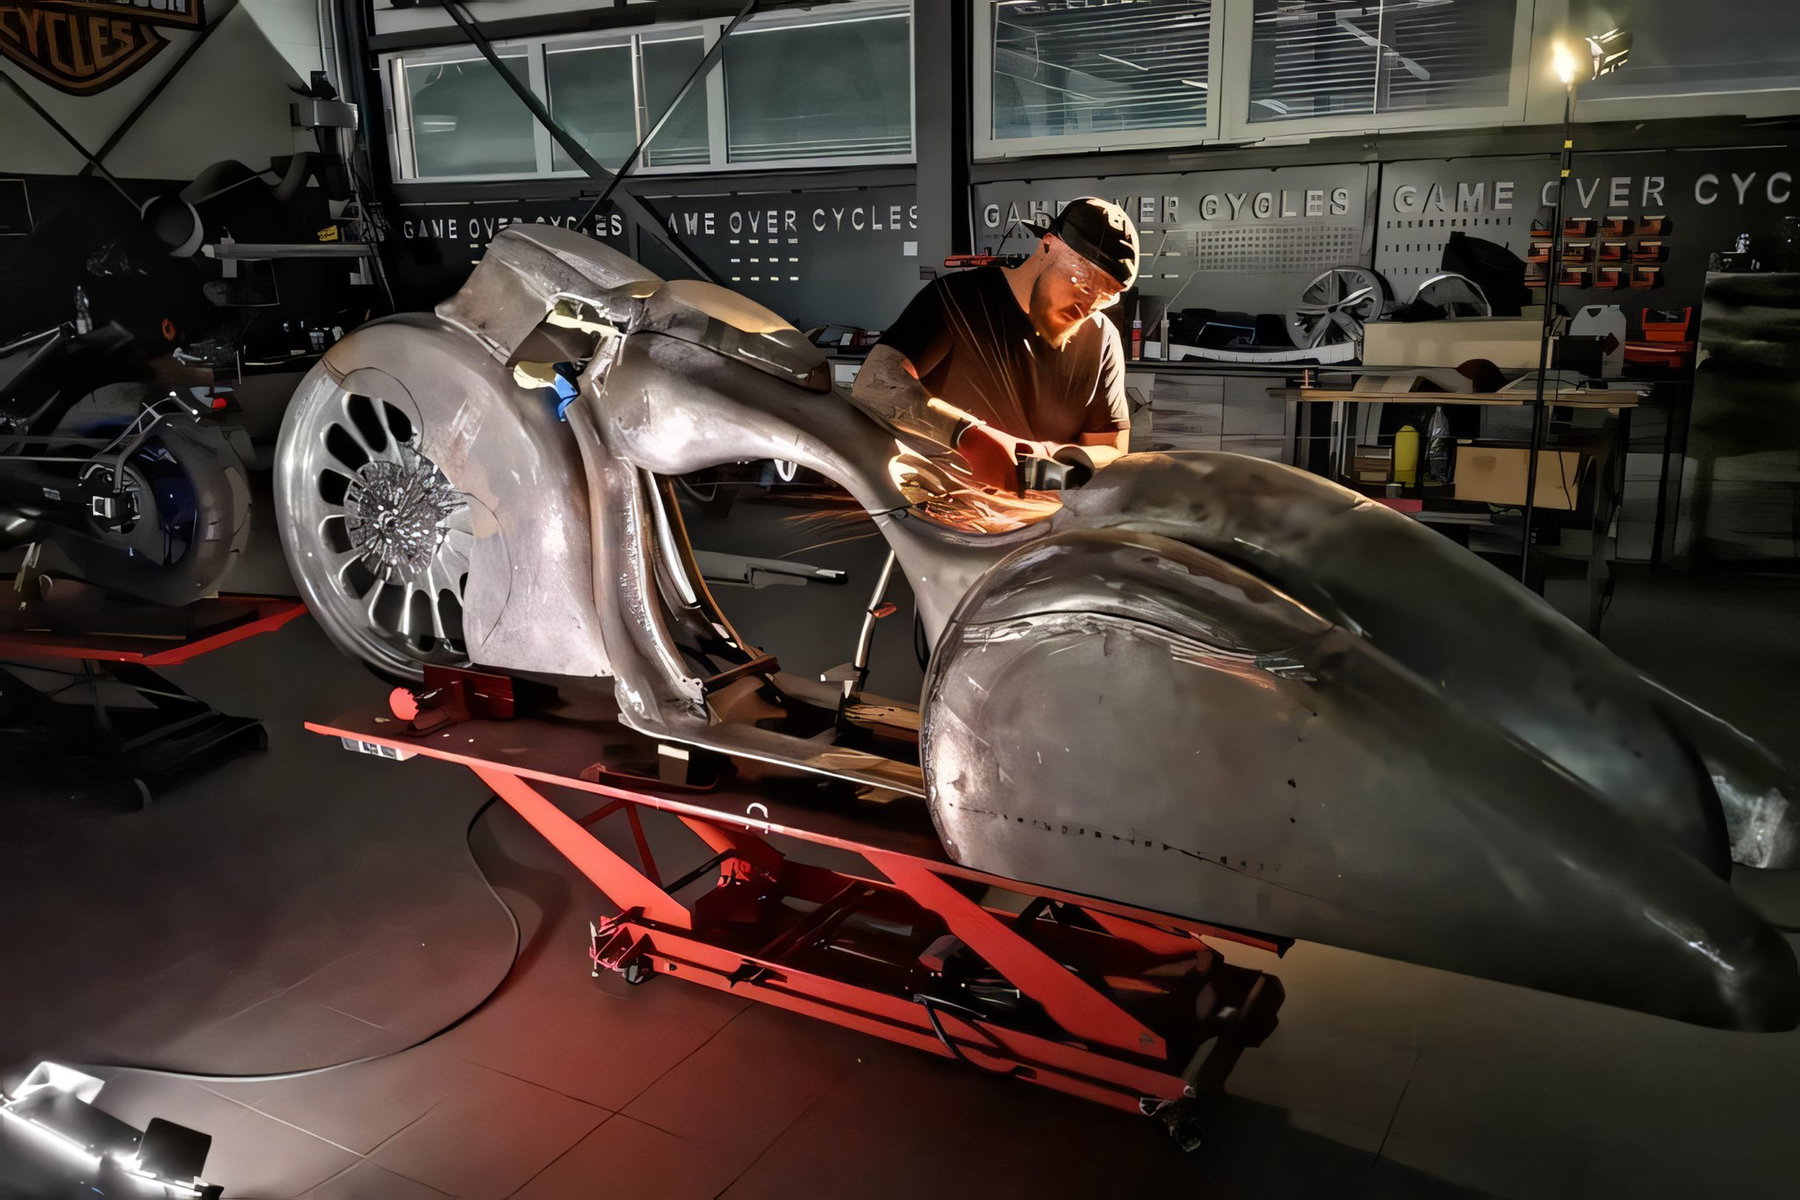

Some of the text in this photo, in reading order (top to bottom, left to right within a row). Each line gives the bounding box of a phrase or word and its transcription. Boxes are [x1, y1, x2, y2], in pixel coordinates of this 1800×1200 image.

[1200, 187, 1350, 221] CYCLES
[1393, 179, 1515, 214] GAME
[403, 217, 458, 240] GAME
[668, 204, 918, 236] AME OVER CYCLES
